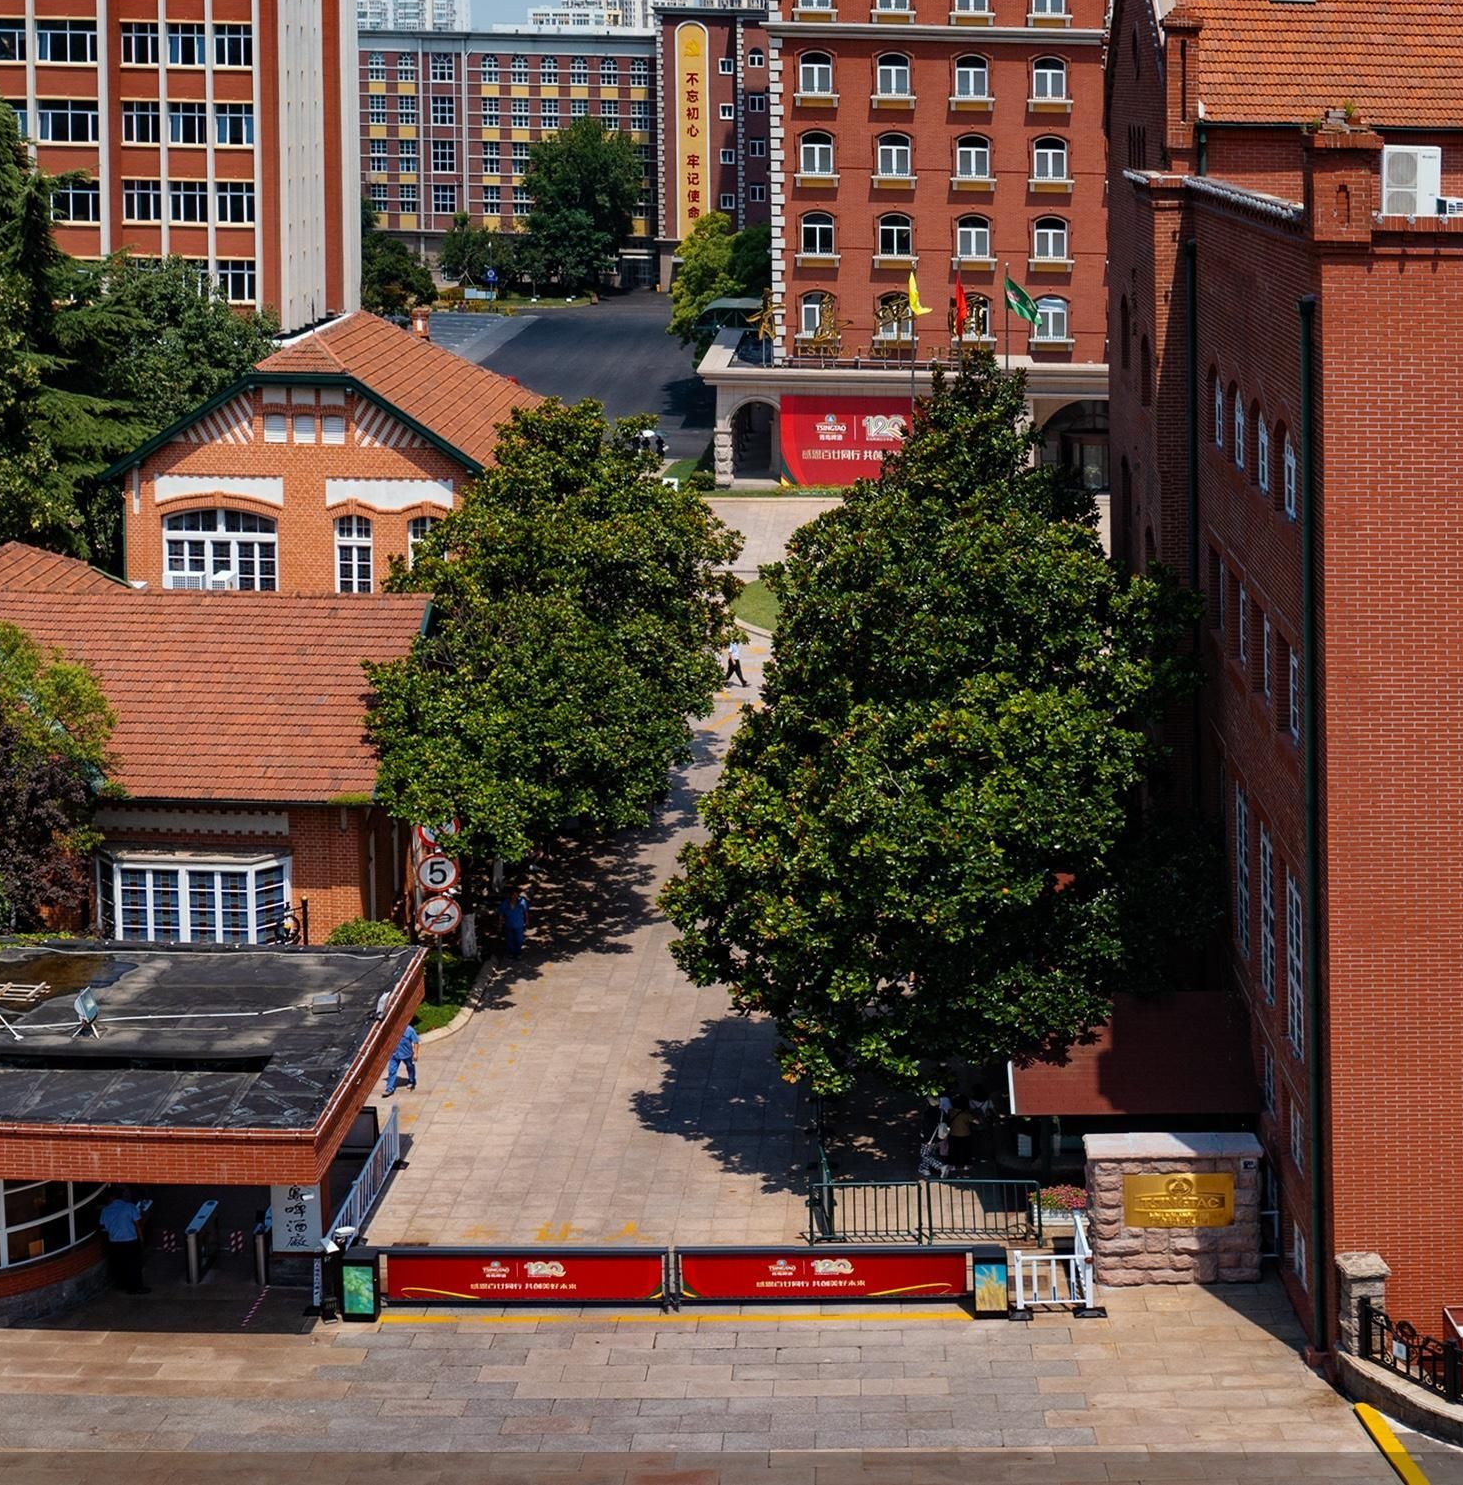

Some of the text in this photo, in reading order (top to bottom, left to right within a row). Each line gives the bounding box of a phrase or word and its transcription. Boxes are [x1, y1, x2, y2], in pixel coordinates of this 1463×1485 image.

[686, 72, 700, 219] 不忘初心 牢记使命
[429, 860, 447, 885] 5
